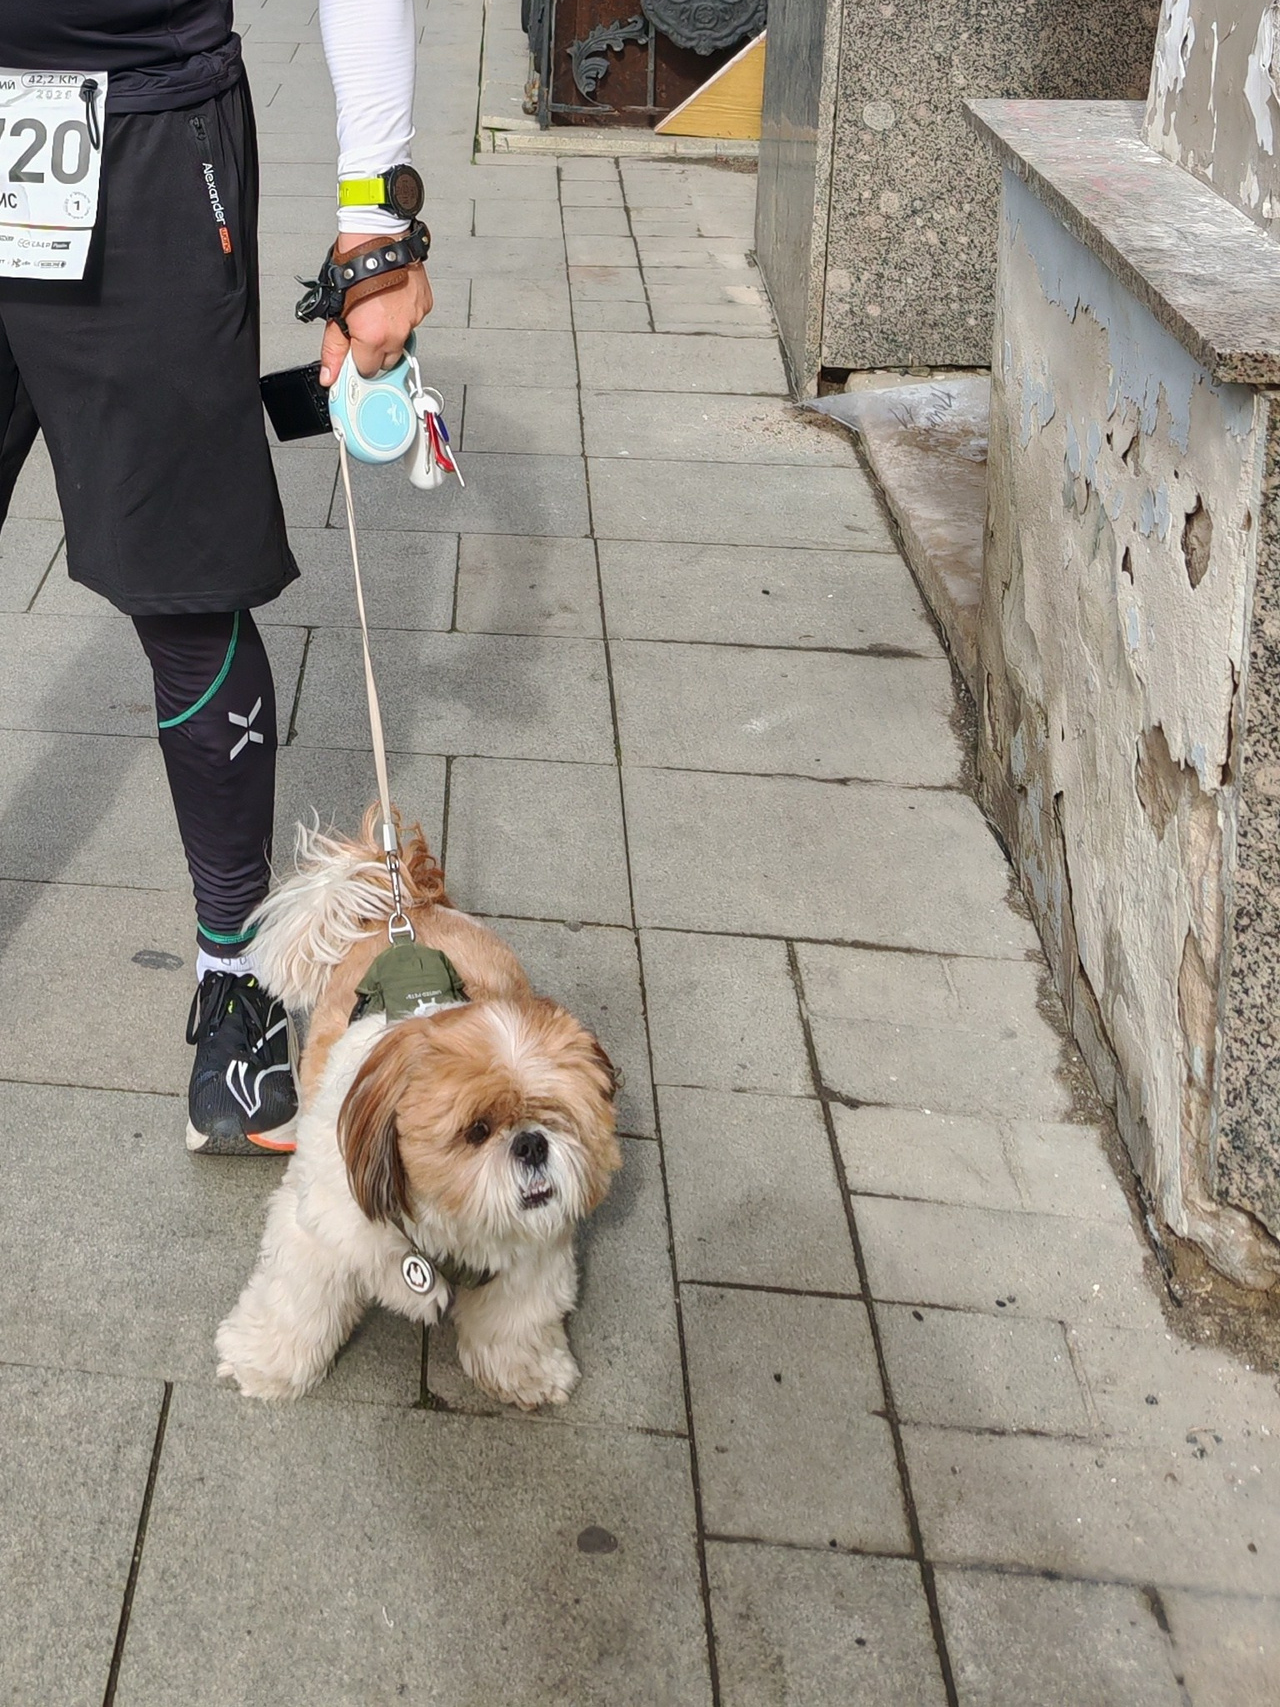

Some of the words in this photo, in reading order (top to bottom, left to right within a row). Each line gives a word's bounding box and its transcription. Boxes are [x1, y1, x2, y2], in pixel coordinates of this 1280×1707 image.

[28, 75, 55, 85] 42,2
[202, 162, 226, 225] Alexander
[74, 200, 81, 211] 1
